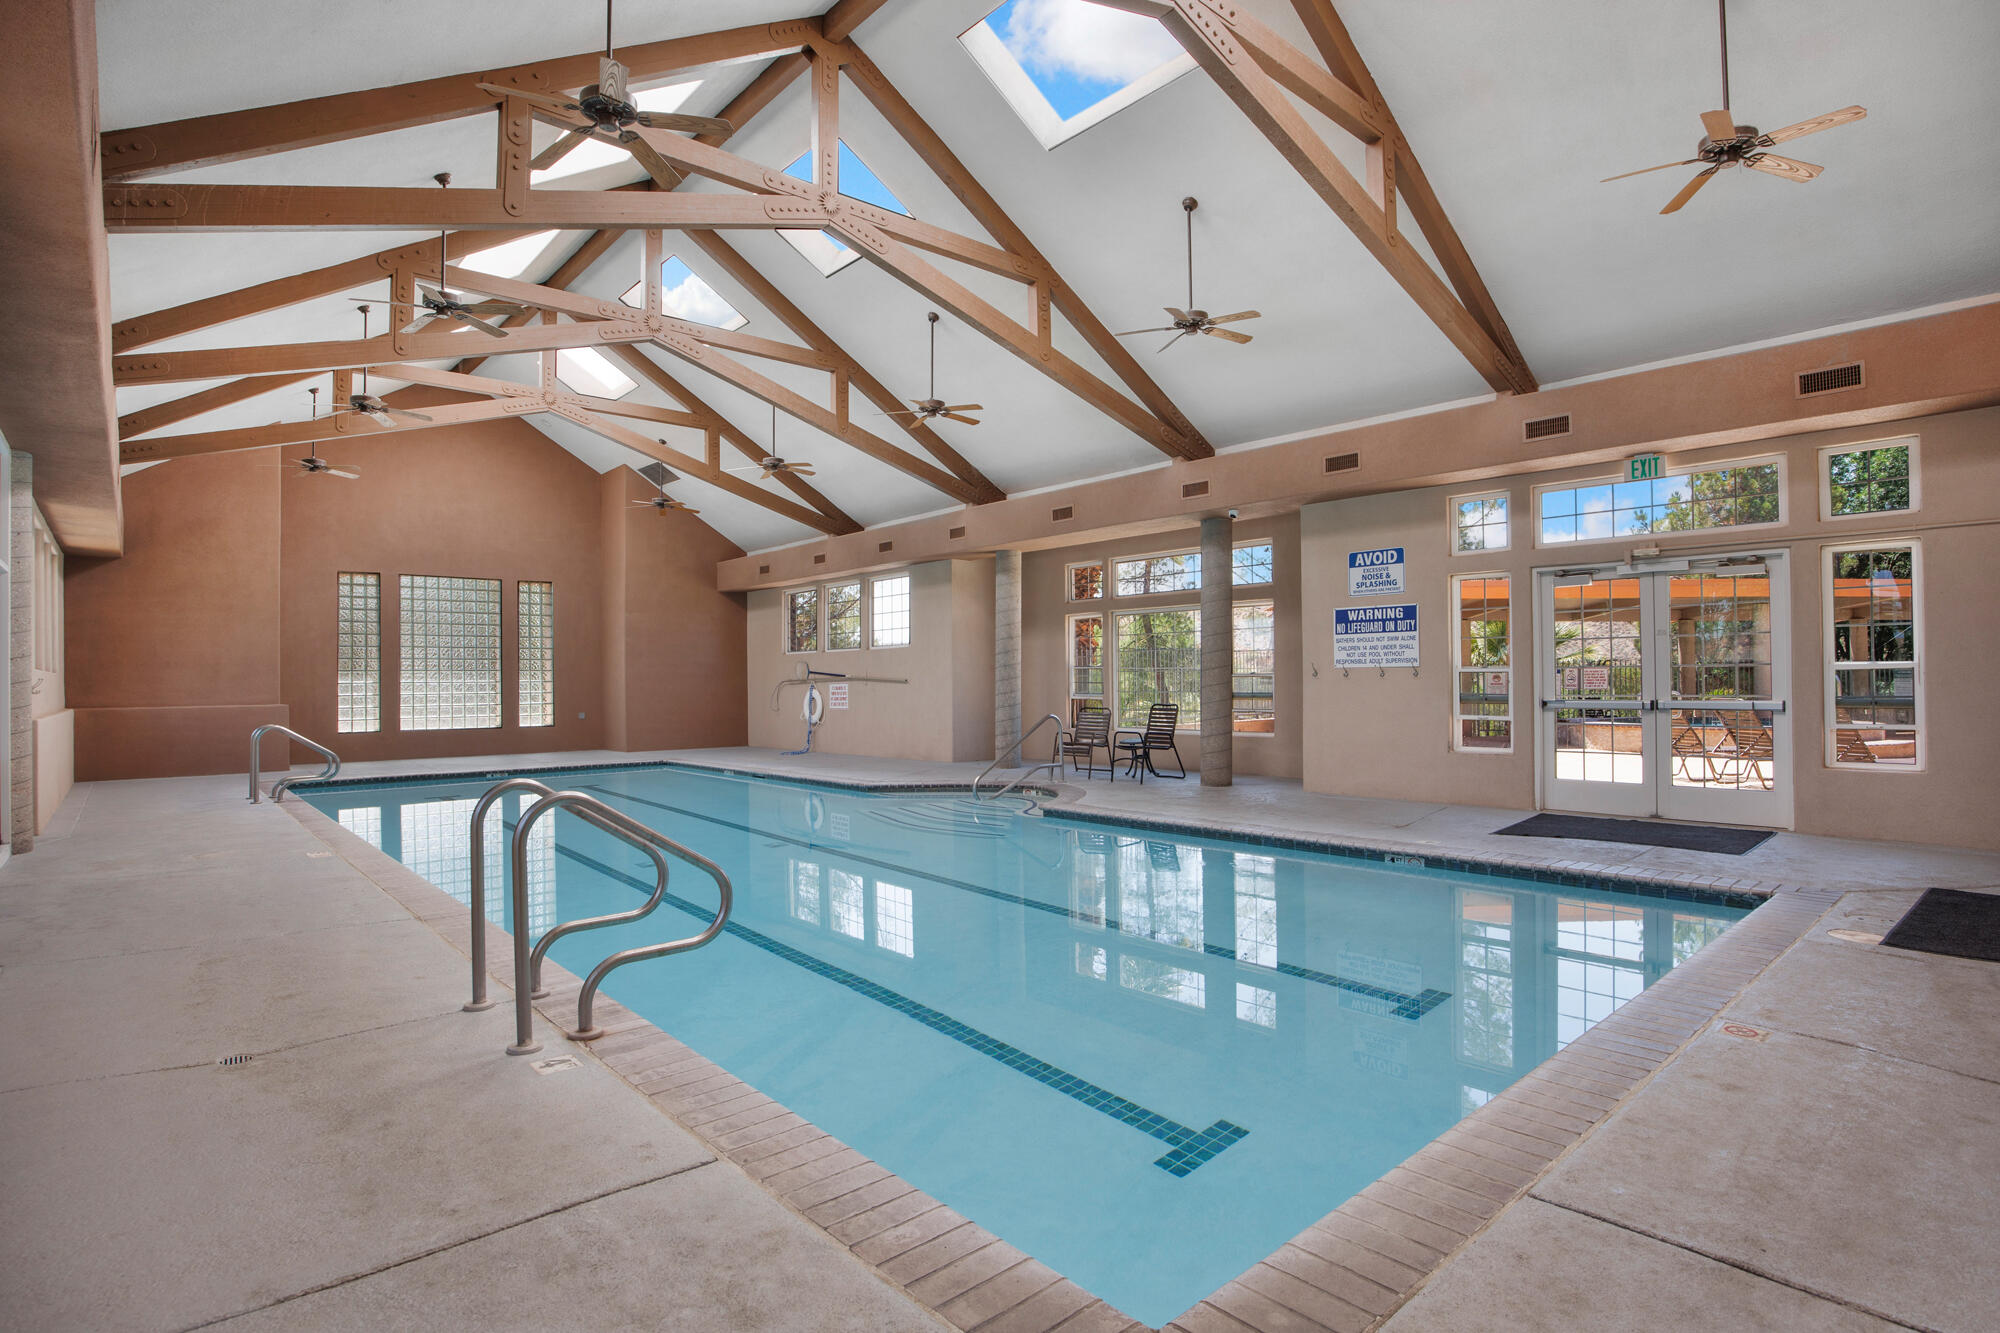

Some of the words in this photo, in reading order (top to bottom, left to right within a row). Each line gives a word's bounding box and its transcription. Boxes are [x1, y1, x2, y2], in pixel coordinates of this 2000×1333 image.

[1632, 457, 1660, 479] EXIT
[1355, 550, 1397, 566] AVOID
[1356, 579, 1397, 588] SPLASHING
[1362, 573, 1383, 581] NOISE
[1348, 608, 1404, 621] WARNING
[1337, 623, 1345, 633] NO
[1348, 622, 1382, 633] LIFEGUARD
[1386, 621, 1394, 631] ON
[1398, 620, 1415, 631] DUTY
